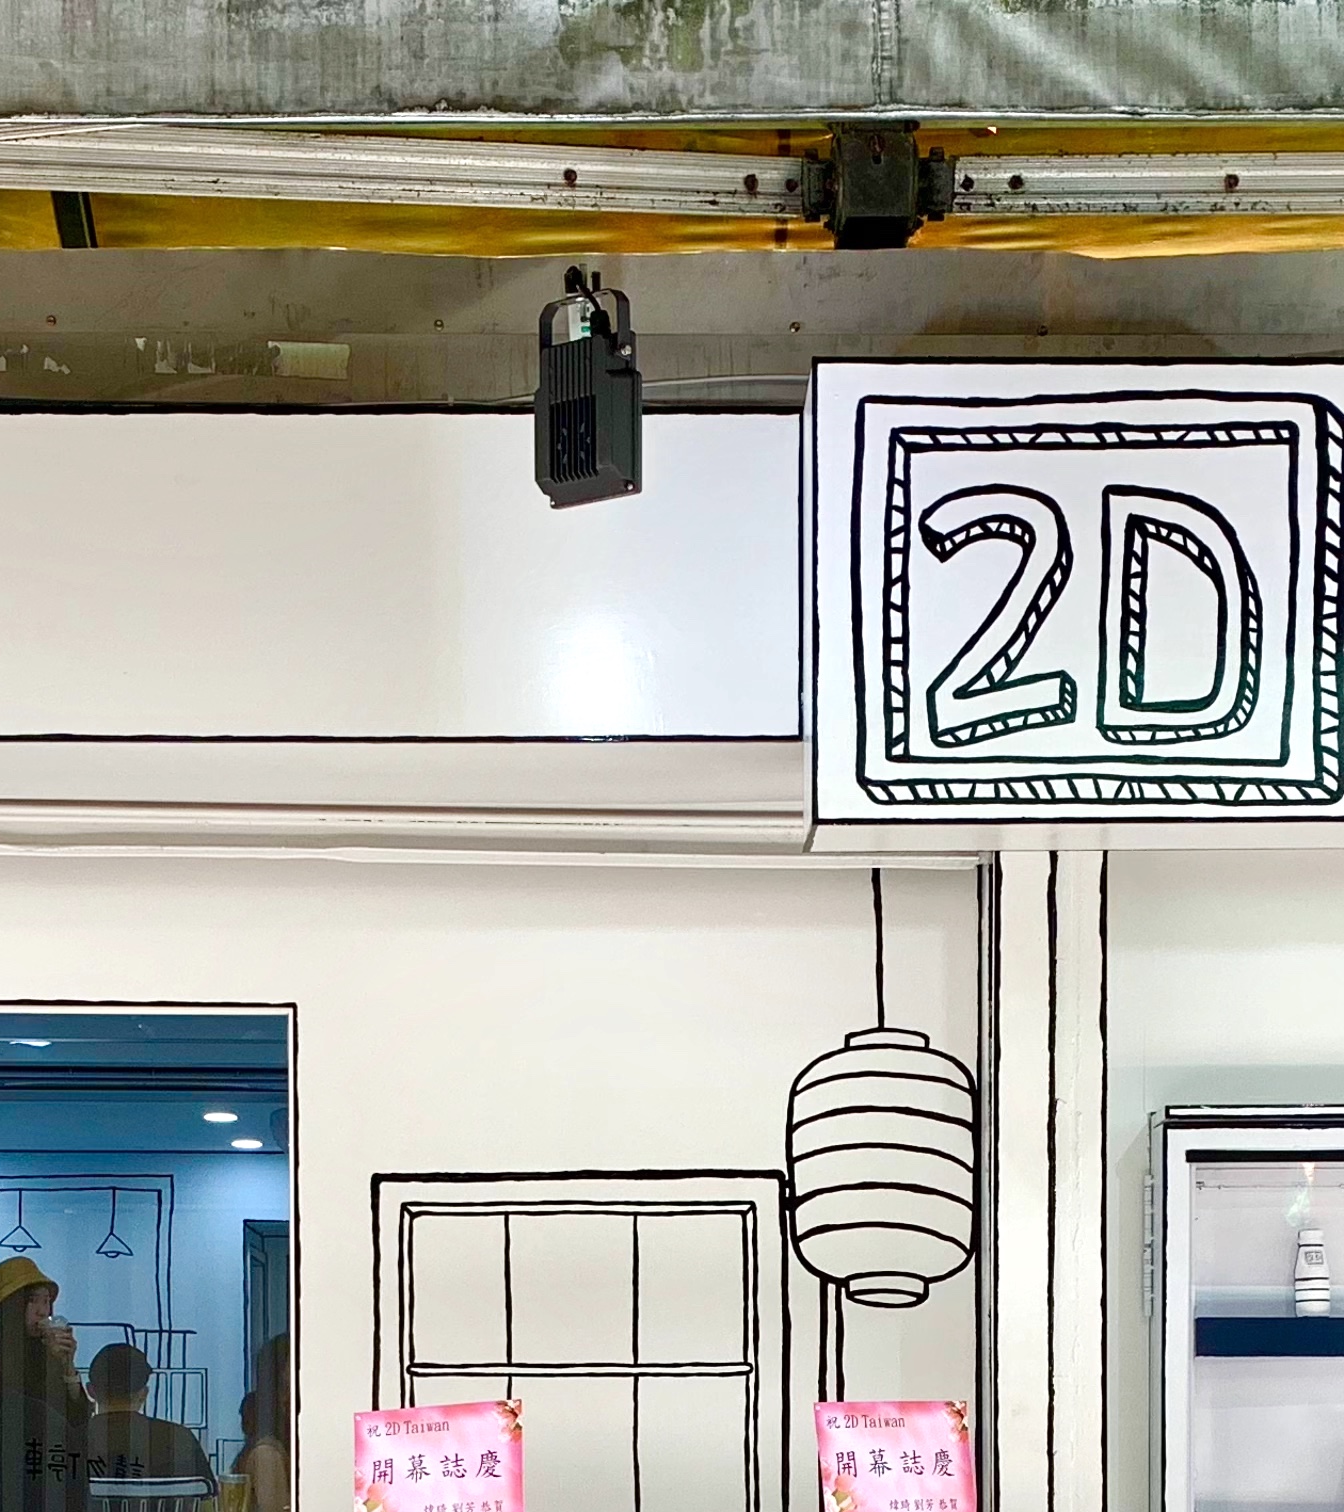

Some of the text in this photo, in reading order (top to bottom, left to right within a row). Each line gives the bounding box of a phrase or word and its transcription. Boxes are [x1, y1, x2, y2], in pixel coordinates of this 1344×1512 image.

[918, 483, 1262, 747] 2D
[367, 1420, 450, 1438] 祝 2D Taiwan
[826, 1414, 905, 1429] 祝 2D Taiwan
[372, 1450, 502, 1485] 開幕誌慶
[836, 1448, 955, 1478] 開幕誌慶
